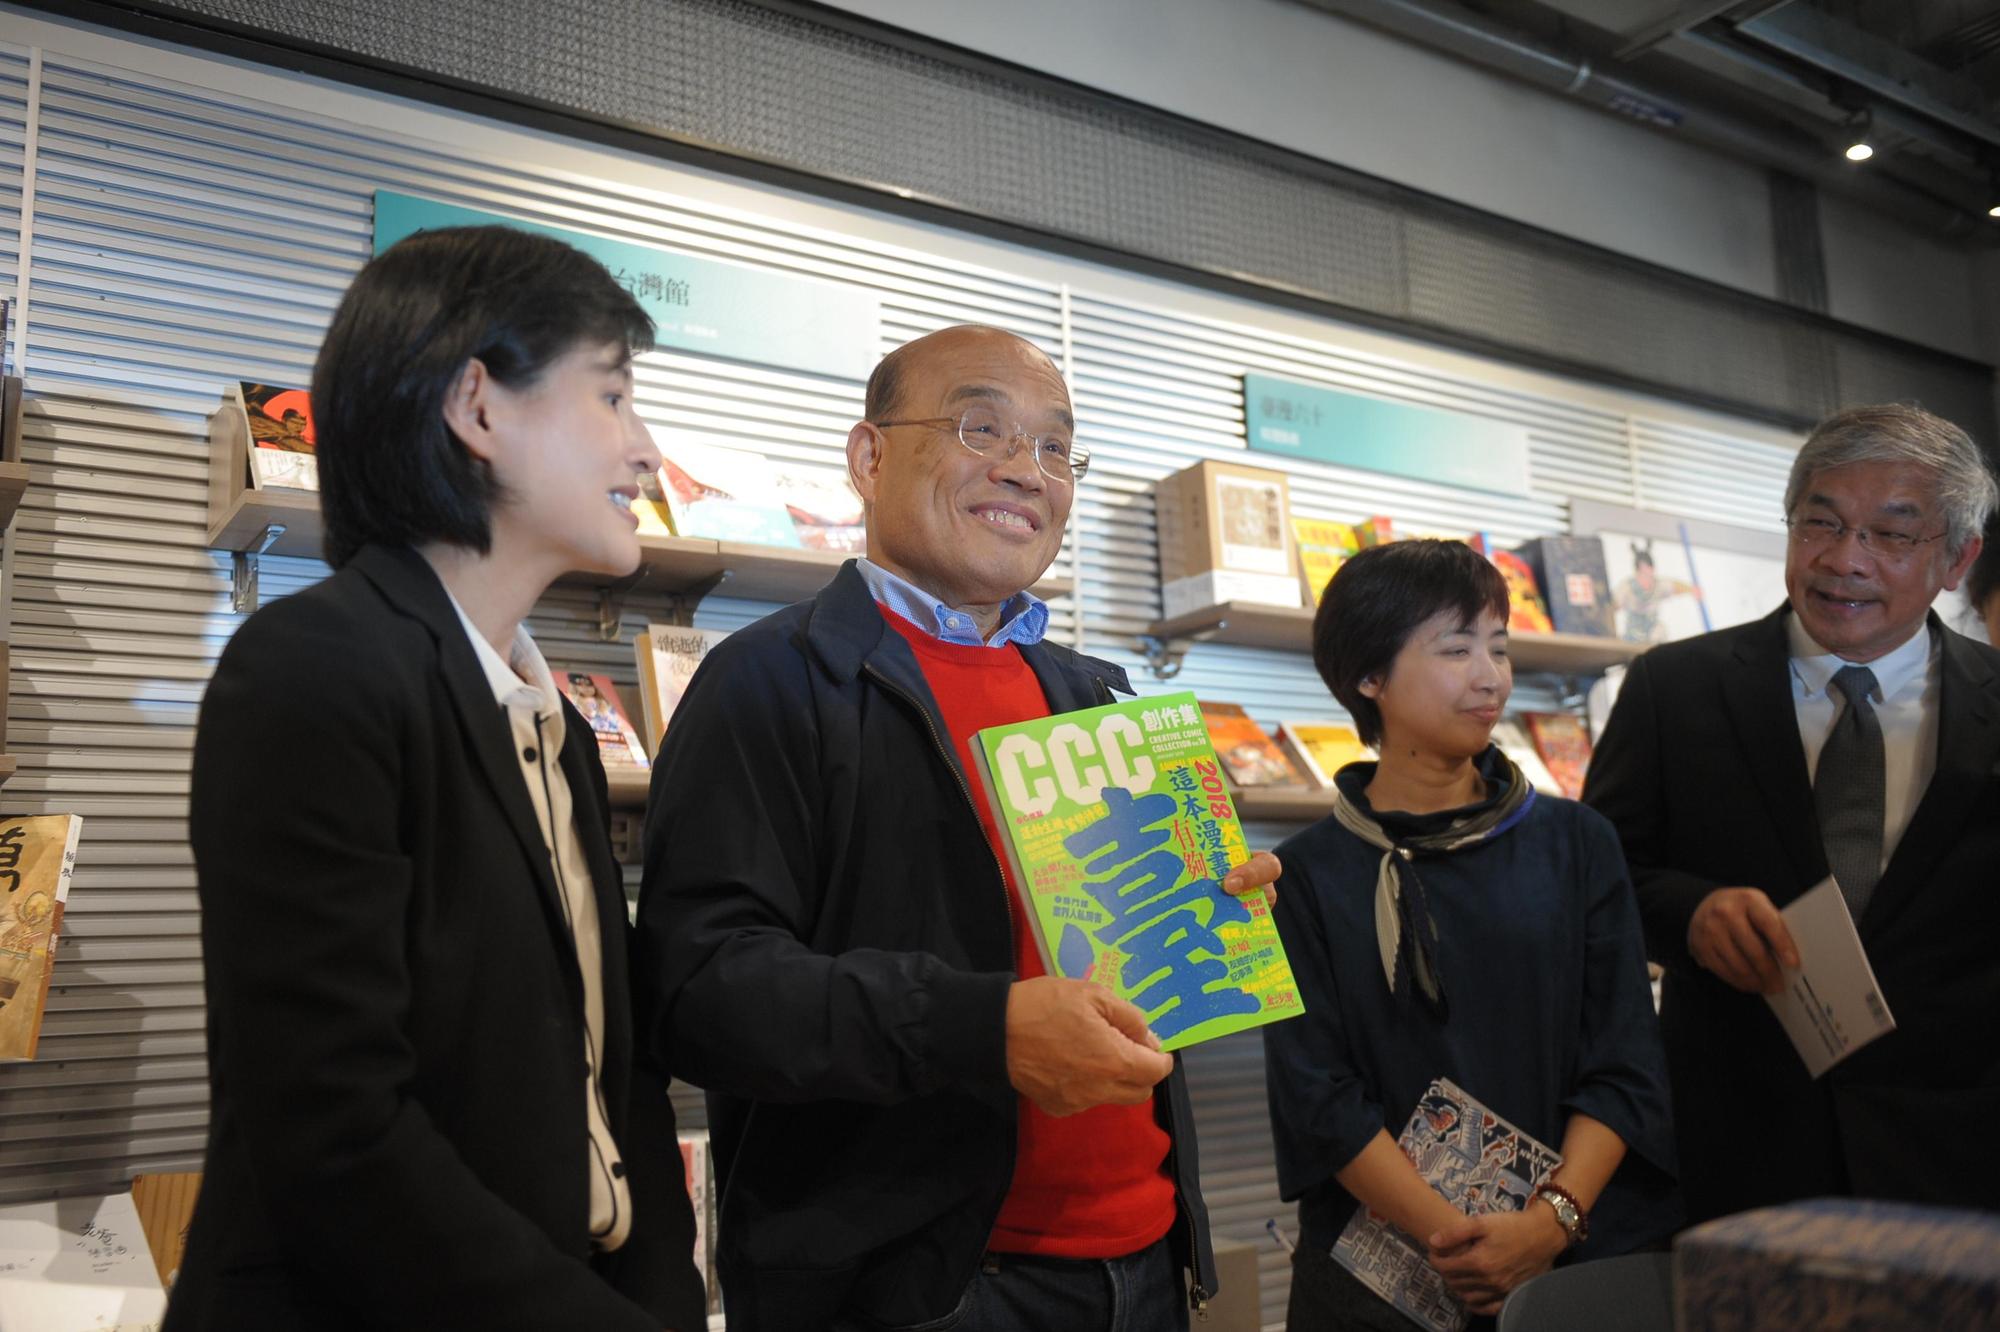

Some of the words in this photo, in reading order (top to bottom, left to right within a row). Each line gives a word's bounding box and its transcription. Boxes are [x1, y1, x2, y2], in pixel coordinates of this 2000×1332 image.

[1140, 703, 1199, 731] 創作集
[1149, 731, 1182, 744] CREATIVE
[1182, 728, 1203, 738] COMIC
[1152, 740, 1191, 752] COLLECTION
[995, 713, 1157, 816] CCC
[1194, 760, 1232, 819] 2018
